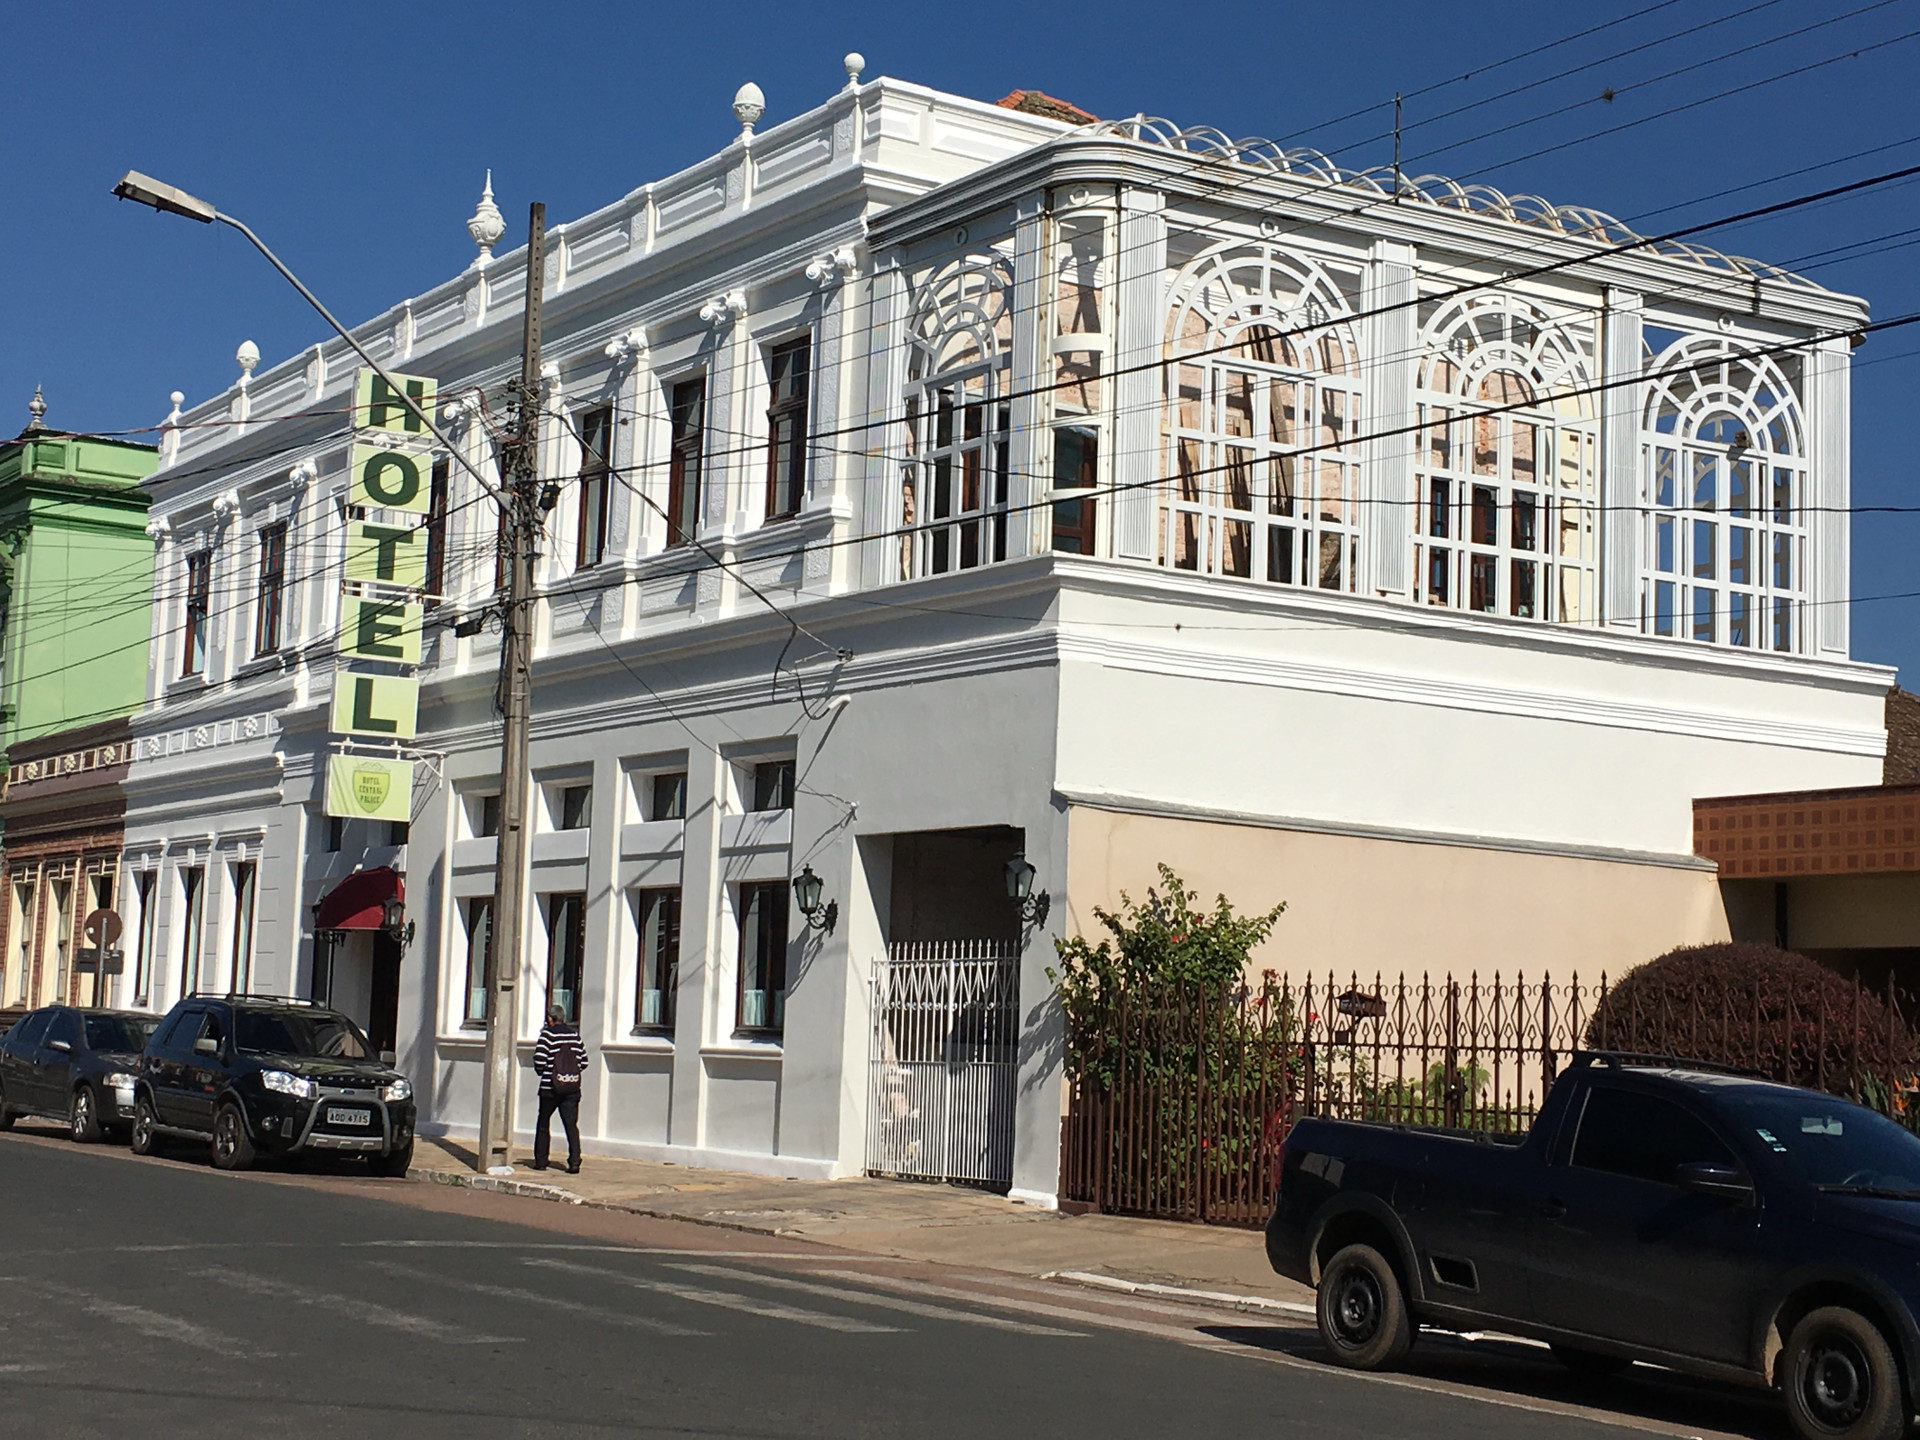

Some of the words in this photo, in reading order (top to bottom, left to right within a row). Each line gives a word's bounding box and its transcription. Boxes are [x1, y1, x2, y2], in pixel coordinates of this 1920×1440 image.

[352, 374, 424, 734] HOTEL
[362, 776, 380, 785] HOTEL
[359, 785, 382, 795] CENTRAL
[360, 794, 381, 804] PALACE
